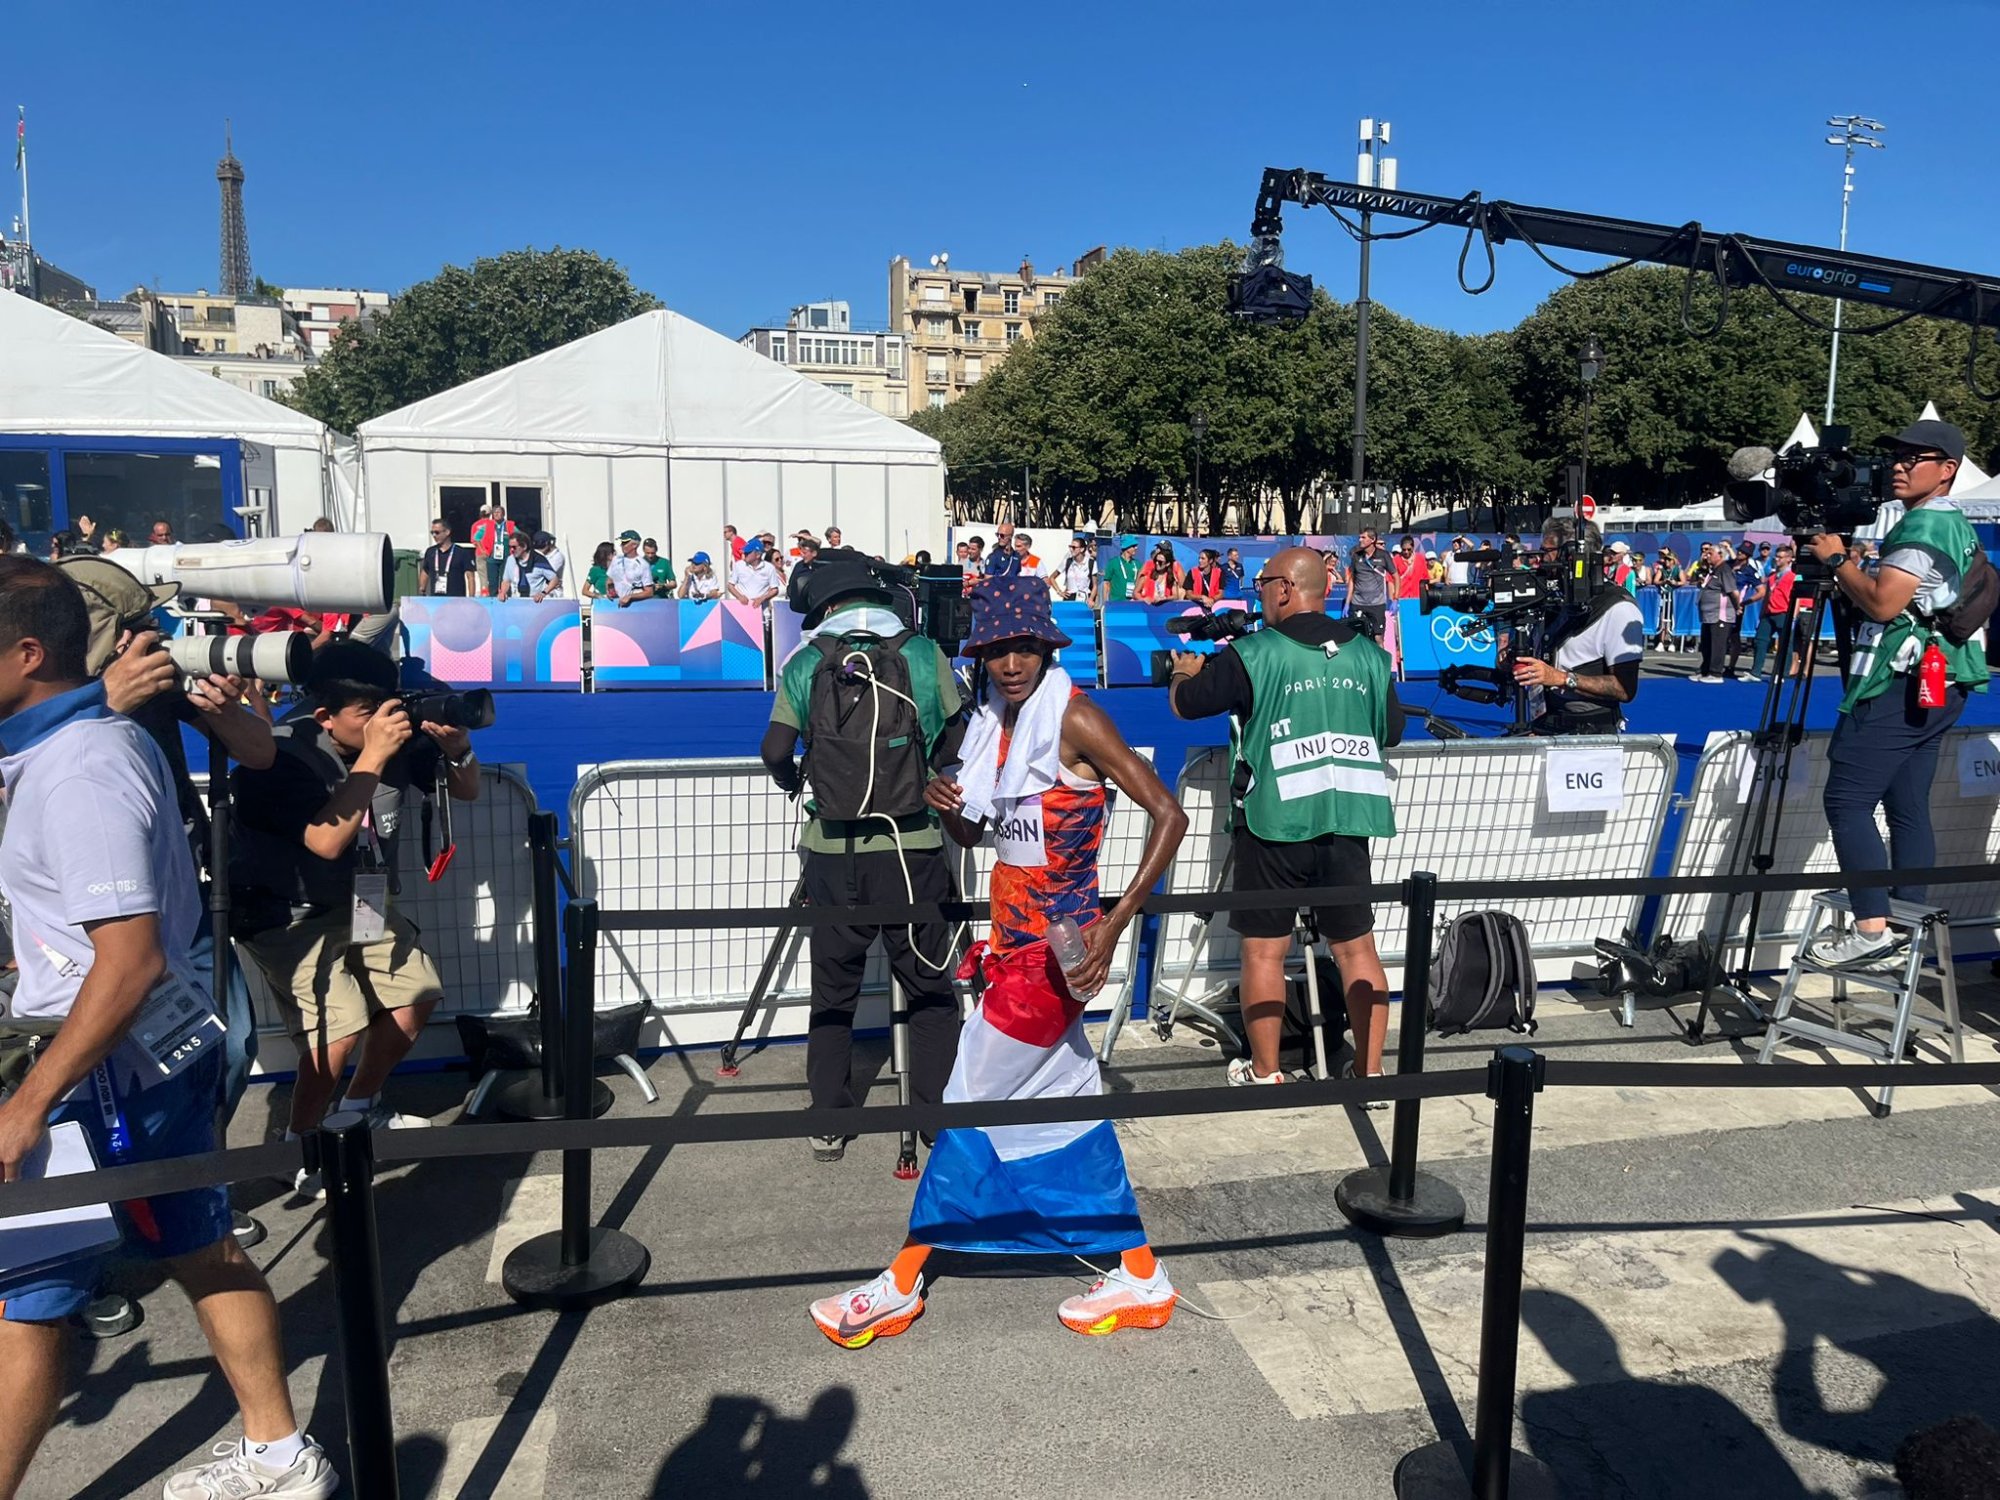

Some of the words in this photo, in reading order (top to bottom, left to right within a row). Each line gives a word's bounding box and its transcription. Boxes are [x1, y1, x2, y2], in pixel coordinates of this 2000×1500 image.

[1786, 263, 1857, 287] eurogrip
[1973, 760, 2000, 778] EN
[1565, 772, 1604, 790] ENG
[172, 1035, 202, 1061] 245
